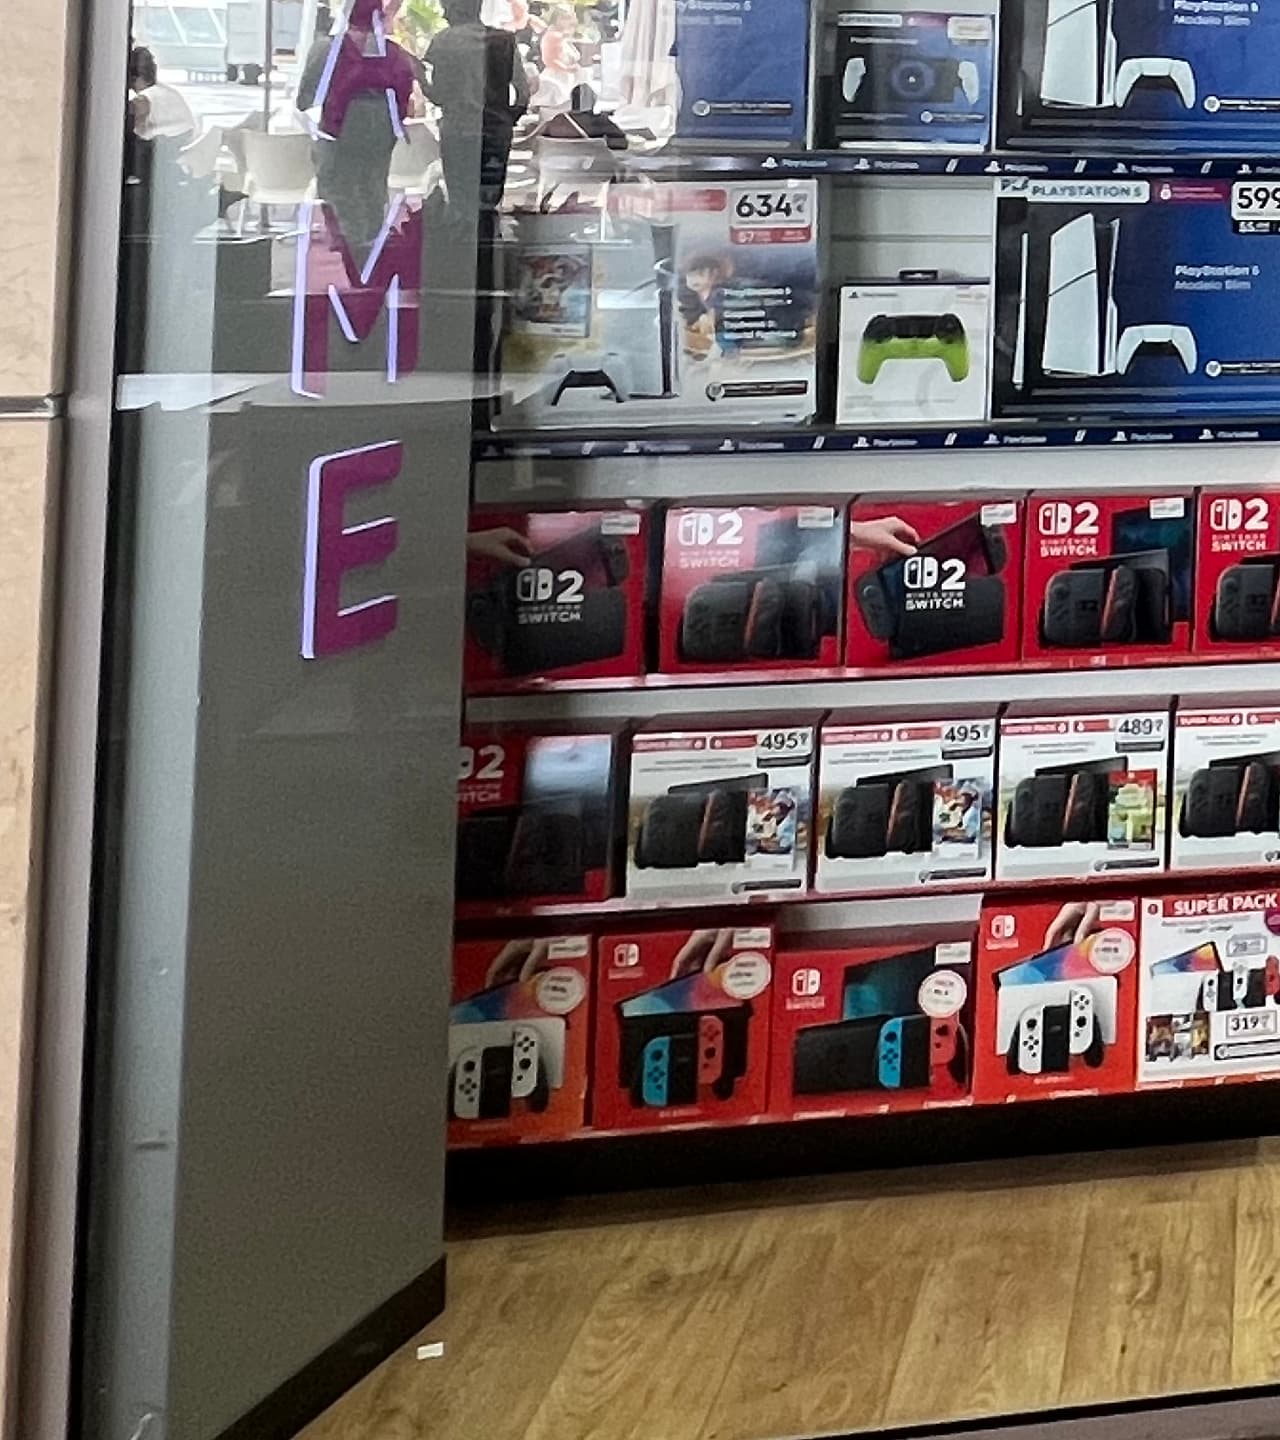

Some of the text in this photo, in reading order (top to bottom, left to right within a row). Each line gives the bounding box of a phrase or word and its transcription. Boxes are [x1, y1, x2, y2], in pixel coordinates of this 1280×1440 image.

[1031, 184, 1132, 199] PLAYSTATION
[735, 192, 793, 220] 634
[1174, 264, 1249, 279] PlayStation
[1040, 544, 1099, 557] SWITCH
[1210, 539, 1268, 553] SWITCH
[906, 597, 966, 611] SWITCH
[518, 611, 582, 625] SWITCH
[944, 724, 981, 743] 495
[1119, 717, 1153, 736] 489
[760, 731, 799, 751] 495
[1173, 892, 1278, 917] SUPER PACK
[1229, 1016, 1260, 1032] 319
